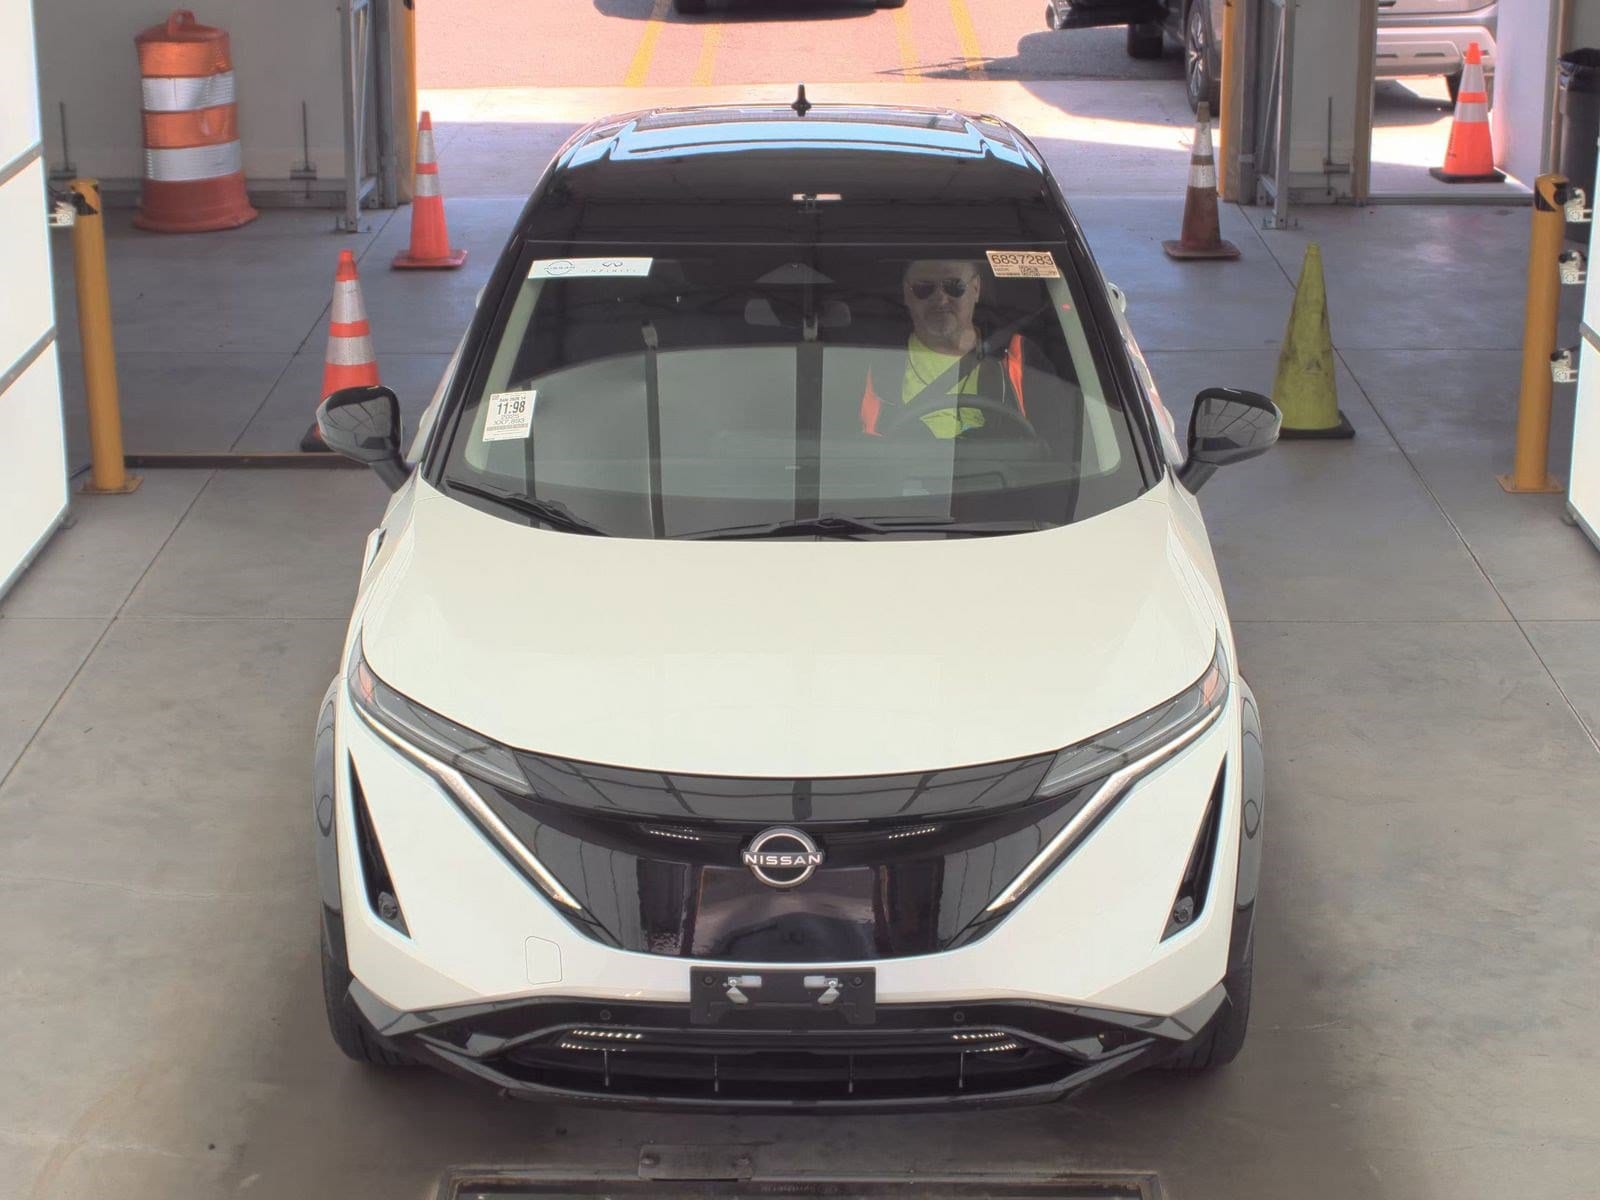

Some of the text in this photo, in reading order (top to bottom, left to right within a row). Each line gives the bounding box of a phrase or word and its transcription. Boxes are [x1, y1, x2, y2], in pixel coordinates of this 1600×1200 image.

[991, 254, 1054, 265] 6837283
[497, 401, 526, 415] 11:98
[745, 854, 821, 866] NISSAN
